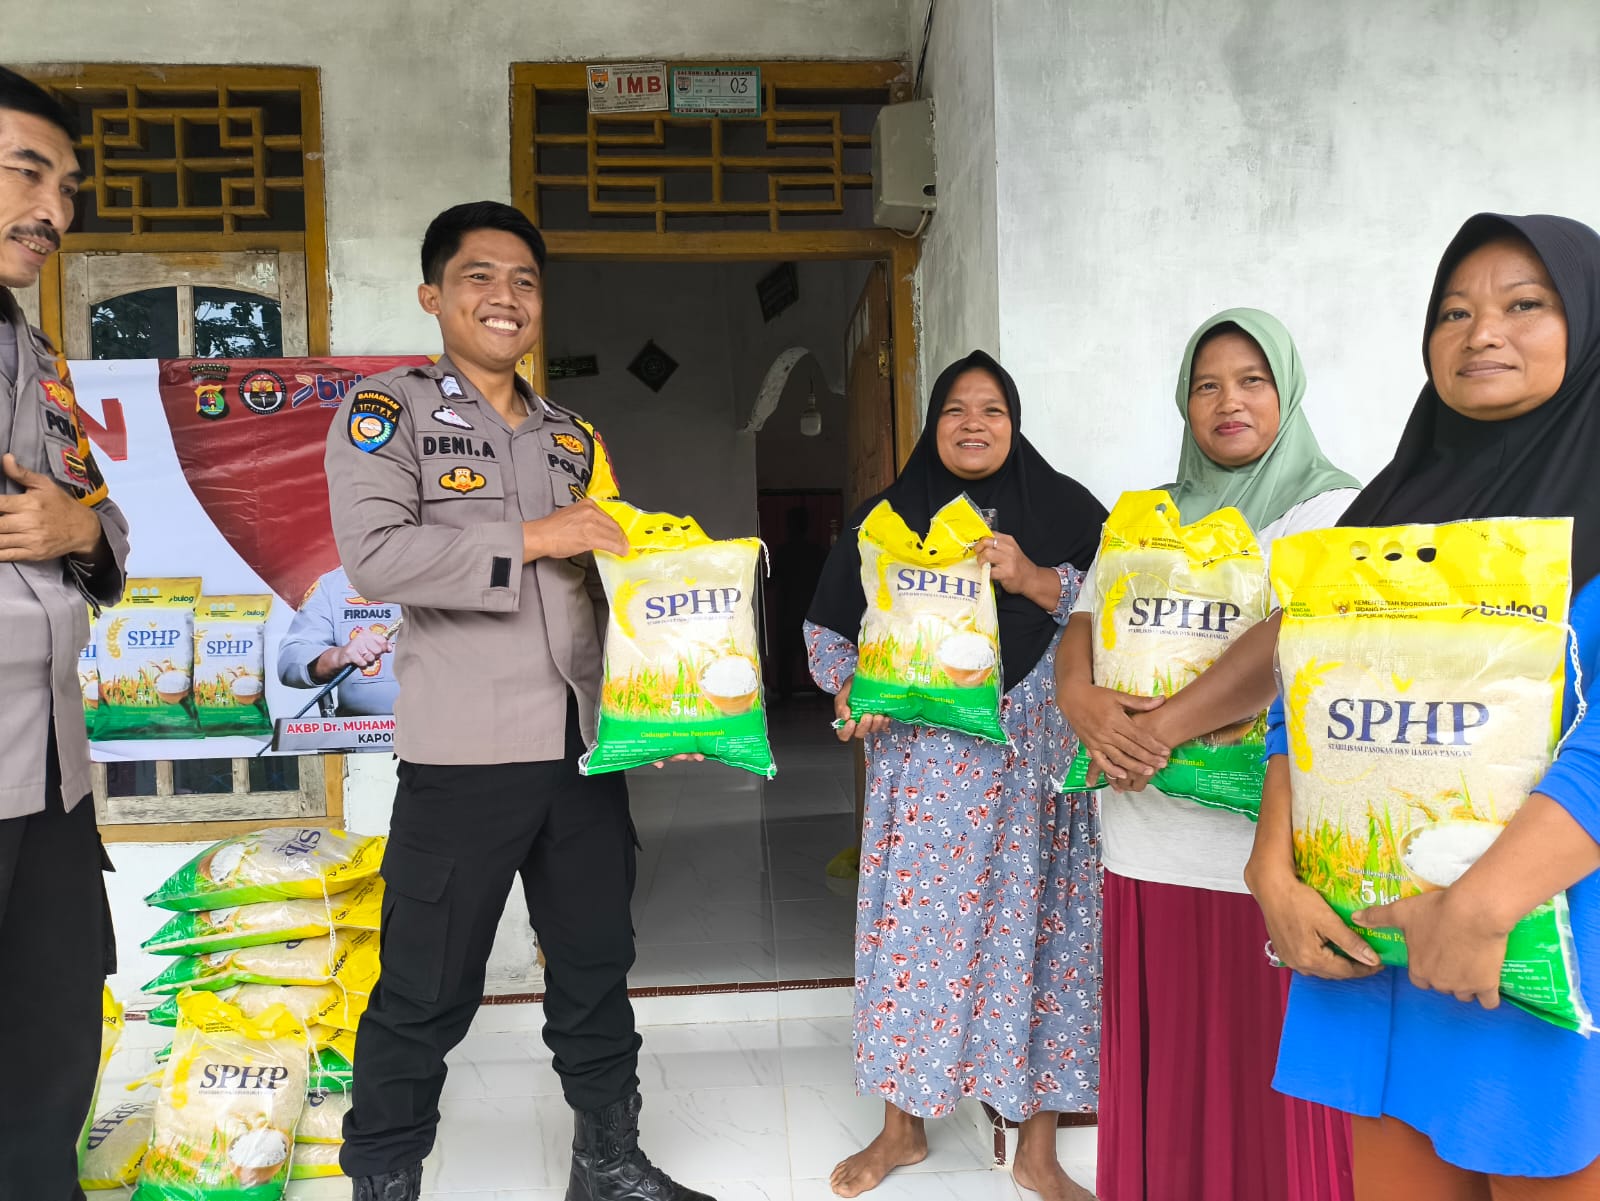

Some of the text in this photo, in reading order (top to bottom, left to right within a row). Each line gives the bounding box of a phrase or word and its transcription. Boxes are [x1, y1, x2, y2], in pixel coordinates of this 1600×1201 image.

[616, 76, 662, 94] IMB
[730, 77, 748, 94] 03
[422, 436, 496, 459] DENI.A
[173, 595, 194, 604] bulog
[645, 587, 742, 620] SPHP
[246, 609, 265, 618] bulog
[343, 609, 392, 619] FIRDAUS
[1128, 597, 1241, 633] SPHP
[1480, 600, 1548, 622] bulog
[127, 629, 181, 646] SPHP
[206, 639, 254, 655] SPHP
[905, 667, 917, 682] 5
[669, 700, 698, 718] 5 kg
[286, 722, 320, 734] AKBP
[323, 722, 341, 732] Dr.
[1327, 697, 1490, 746] SPHP
[358, 733, 394, 744] KAPO
[1361, 879, 1377, 905] 5
[199, 1063, 289, 1090] SPHP
